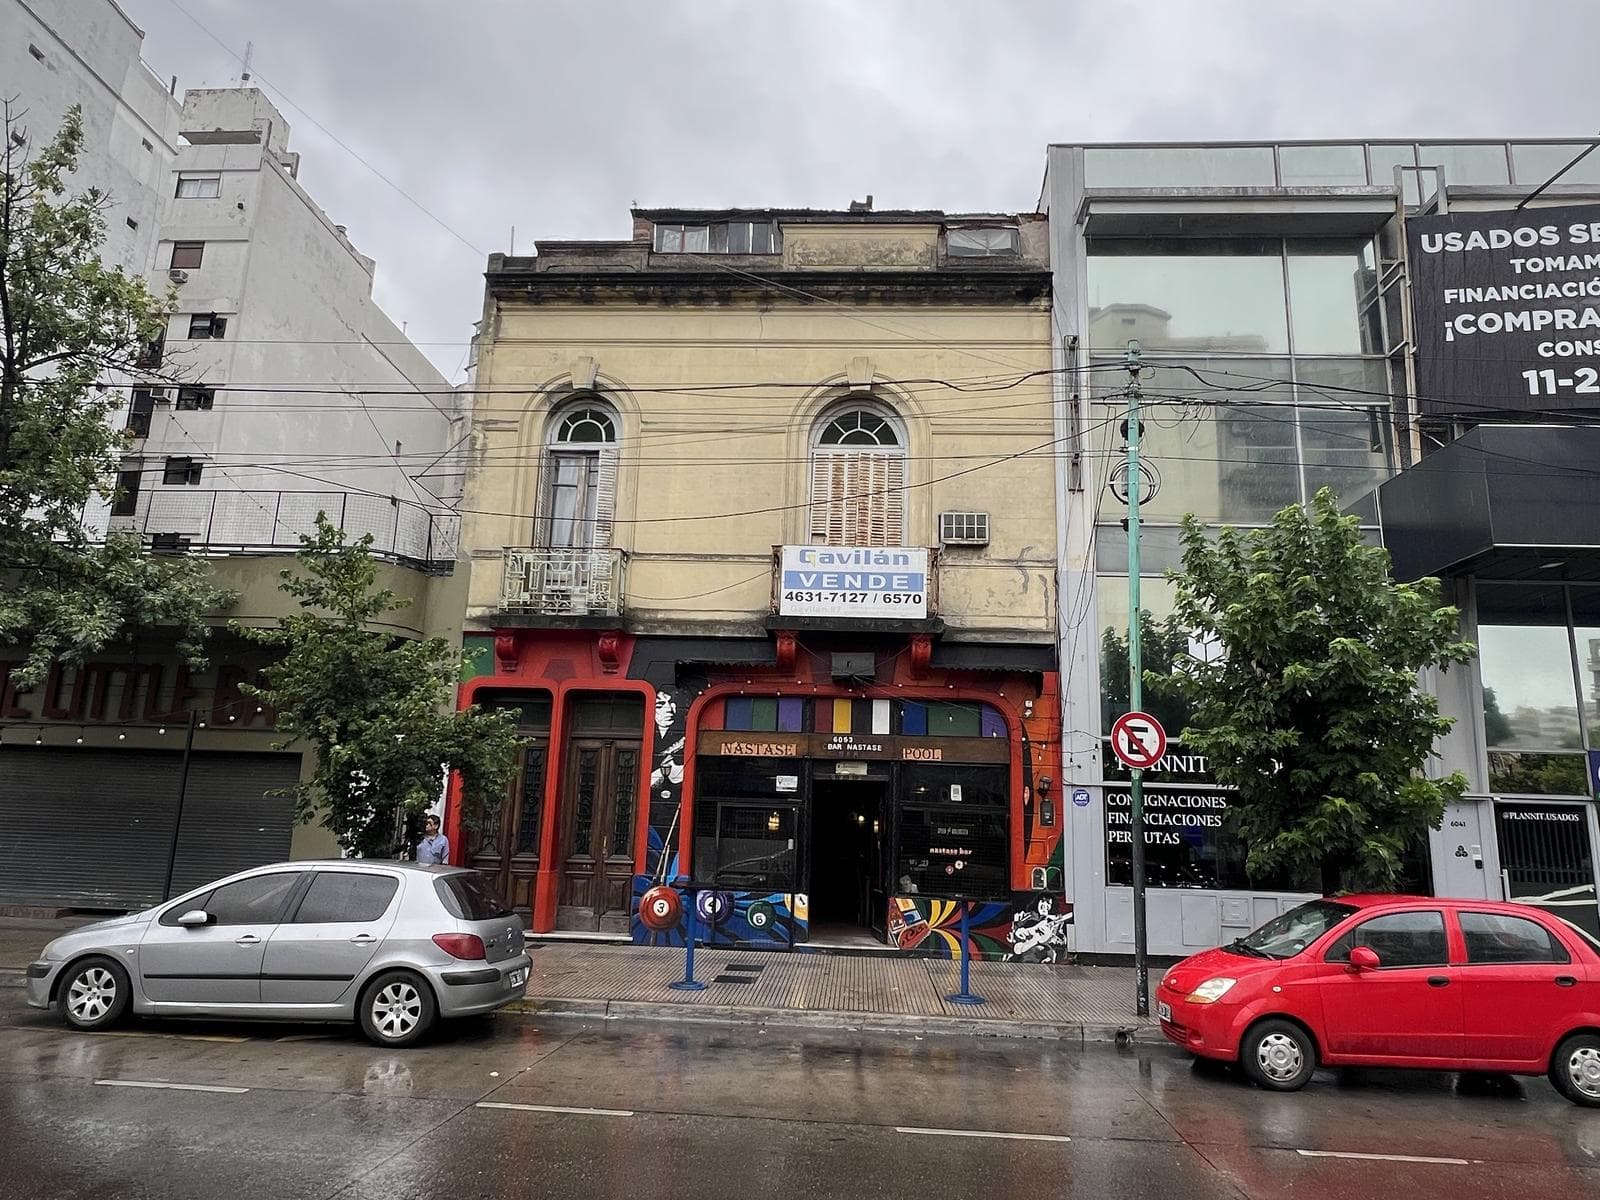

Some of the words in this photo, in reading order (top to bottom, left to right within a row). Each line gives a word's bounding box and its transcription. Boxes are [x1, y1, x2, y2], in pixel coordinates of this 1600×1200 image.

[1421, 225, 1560, 253] USADOS
[1510, 253, 1600, 274] TOMAM
[1444, 276, 1600, 304] FINANCIACIÓ
[1445, 307, 1600, 342] ¡COMPRA
[799, 549, 909, 567] Gavilán
[799, 573, 909, 589] VENDE
[785, 591, 868, 604] 4631-7127
[883, 593, 922, 605] 6570
[723, 742, 796, 756] NASTASE
[847, 744, 883, 752] NASTASE
[904, 748, 941, 760] POOL
[1107, 793, 1227, 808] CONIGNACIONES
[1108, 812, 1222, 827] FINNCIACIONES
[1108, 830, 1180, 844] PERUTAS
